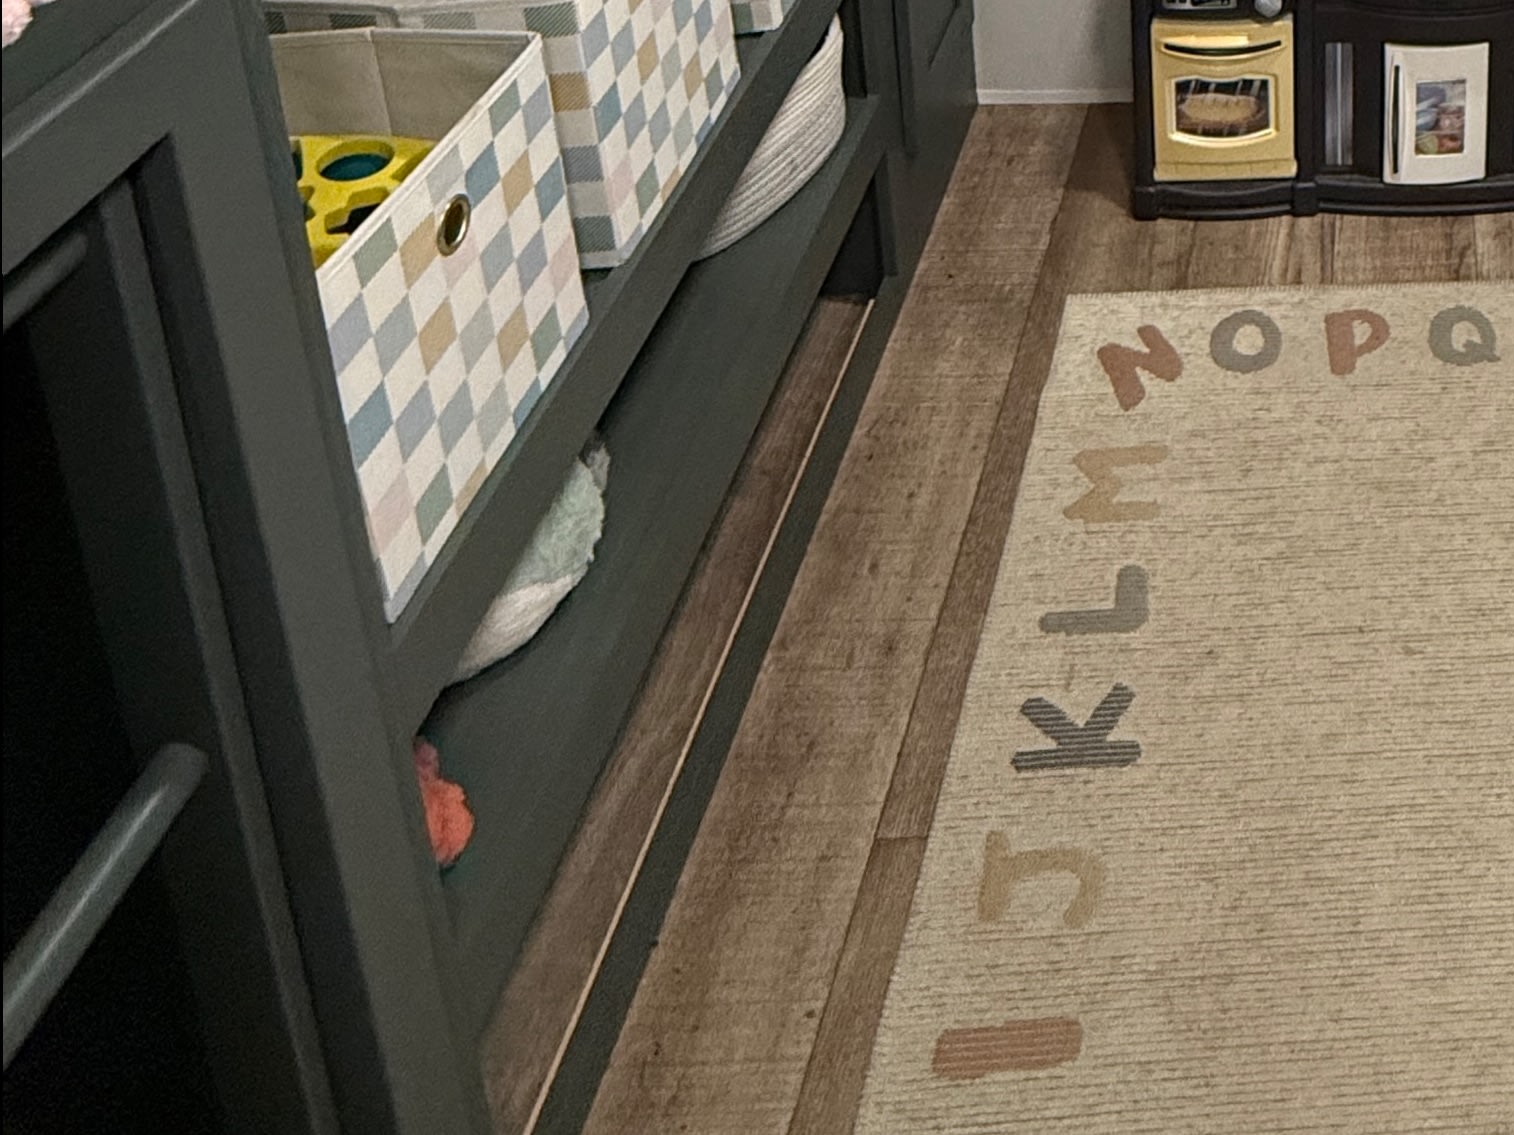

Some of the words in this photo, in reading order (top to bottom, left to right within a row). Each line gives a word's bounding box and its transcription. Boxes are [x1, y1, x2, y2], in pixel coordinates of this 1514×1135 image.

[1097, 325, 1184, 411] N
[1210, 310, 1282, 372] O
[1323, 310, 1391, 375] P
[1428, 306, 1498, 367] Q
[1063, 444, 1170, 523] M
[1038, 565, 1149, 633] L
[1010, 683, 1142, 772] K
